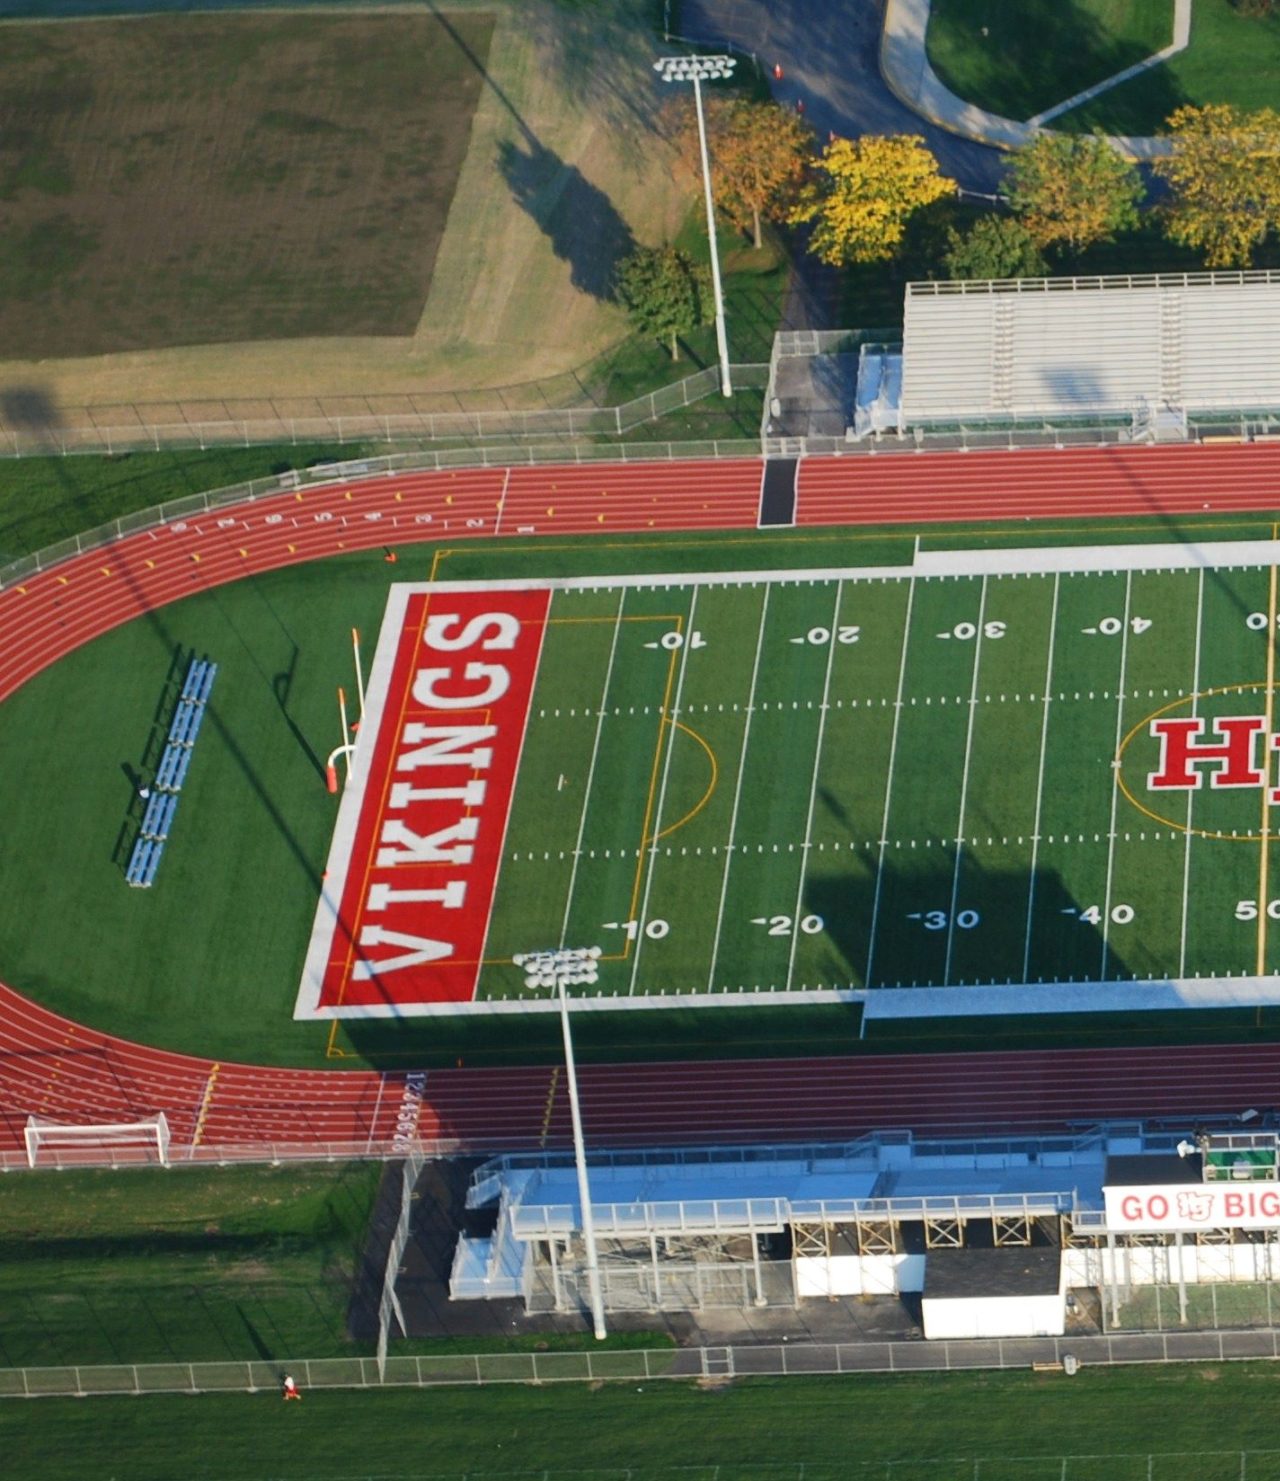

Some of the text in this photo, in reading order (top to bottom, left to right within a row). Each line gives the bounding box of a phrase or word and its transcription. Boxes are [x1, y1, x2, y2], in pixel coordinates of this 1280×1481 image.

[415, 513, 432, 523] 3
[466, 519, 484, 528] 2
[807, 625, 860, 645] 20
[953, 621, 1007, 640] 30
[1099, 616, 1152, 636] 40
[661, 631, 707, 650] 10
[352, 612, 521, 981] VIKINGS
[924, 910, 979, 930] 30
[1078, 904, 1134, 925] 40
[621, 920, 669, 940] 10
[768, 915, 824, 935] 20
[1121, 1195, 1169, 1221] GO
